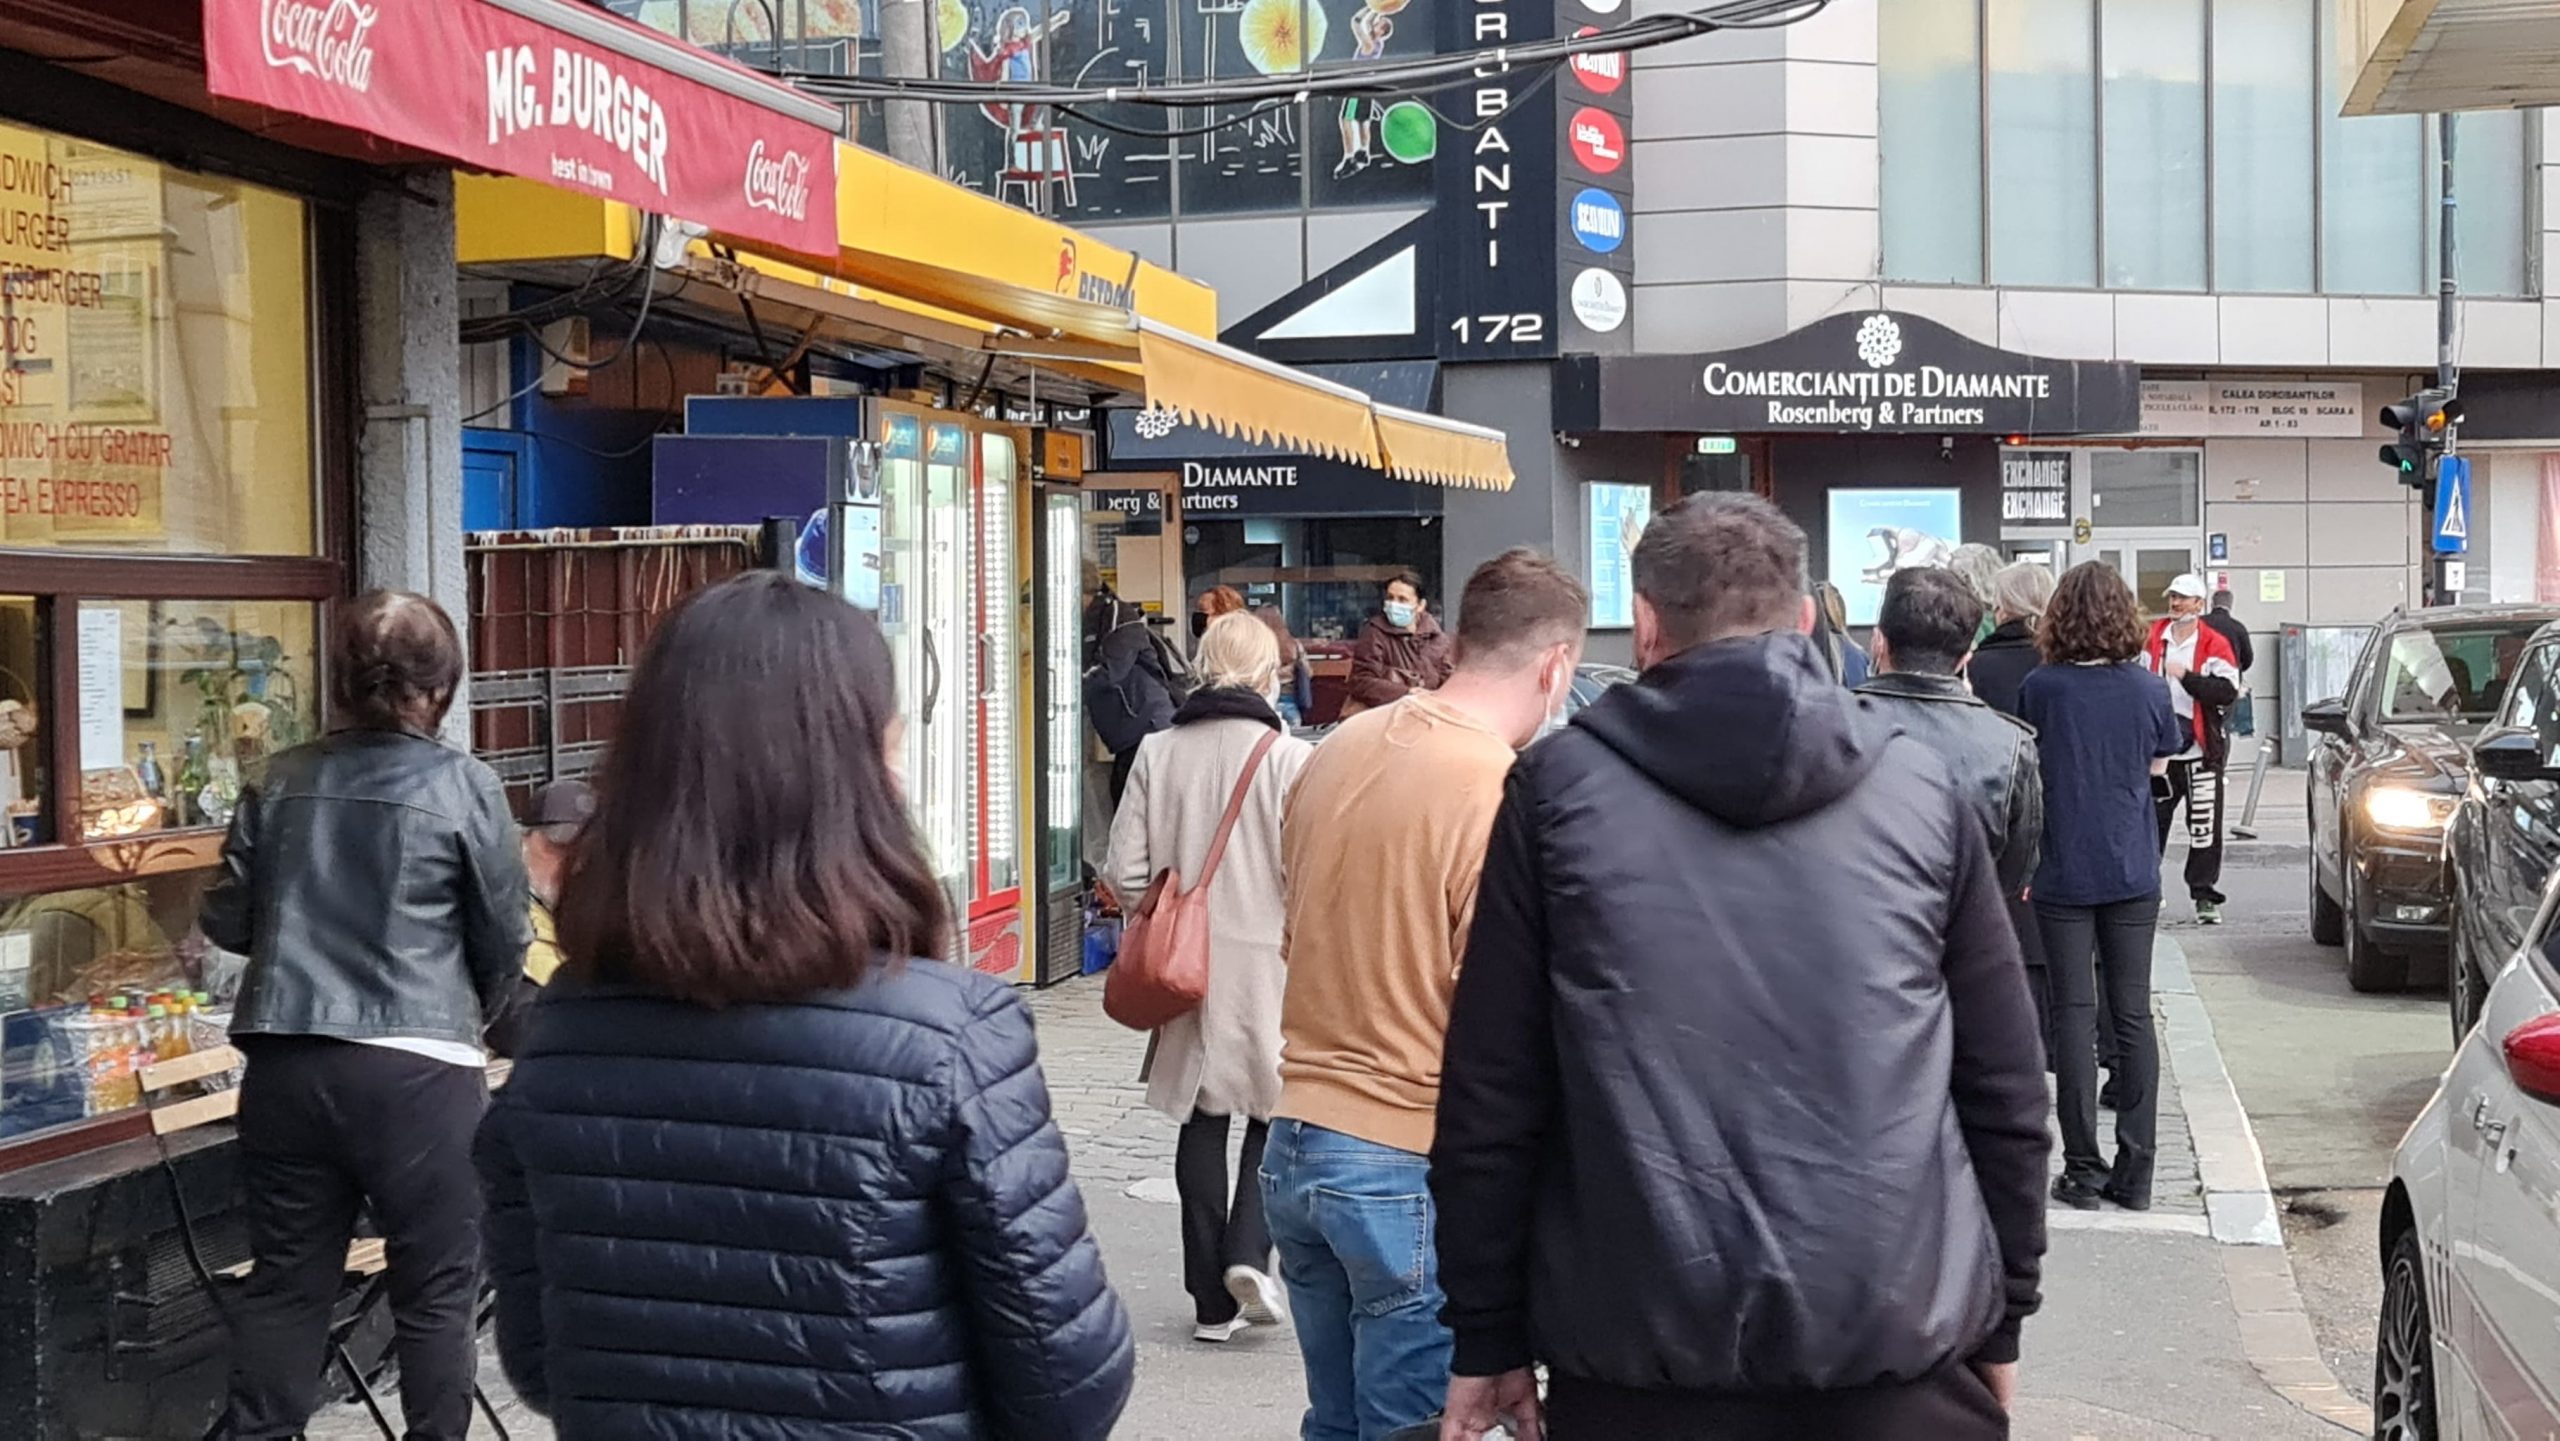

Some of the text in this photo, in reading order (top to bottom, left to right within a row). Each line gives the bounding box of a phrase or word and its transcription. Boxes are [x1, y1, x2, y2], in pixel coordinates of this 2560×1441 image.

[485, 45, 668, 196] MG. BURGER
[551, 152, 613, 191] best in town
[744, 139, 810, 221] Coca-Cola
[0, 315, 36, 353] OG
[1450, 313, 1543, 344] 172
[1884, 373, 1916, 398] DE
[1920, 365, 2050, 399] DIAMANTE
[2222, 389, 2256, 399] CALEA
[1768, 400, 1984, 430] Rosenberg & Partners
[0, 423, 58, 459] WICH
[64, 423, 92, 460] CU
[1183, 462, 1298, 488] DIAMANTE
[2003, 461, 2065, 488] EXCHANGE
[0, 477, 140, 518] EA EXPRESSO
[1146, 493, 1160, 510] &
[1182, 493, 1239, 510] rtners
[2002, 491, 2066, 519] EXCHANGE
